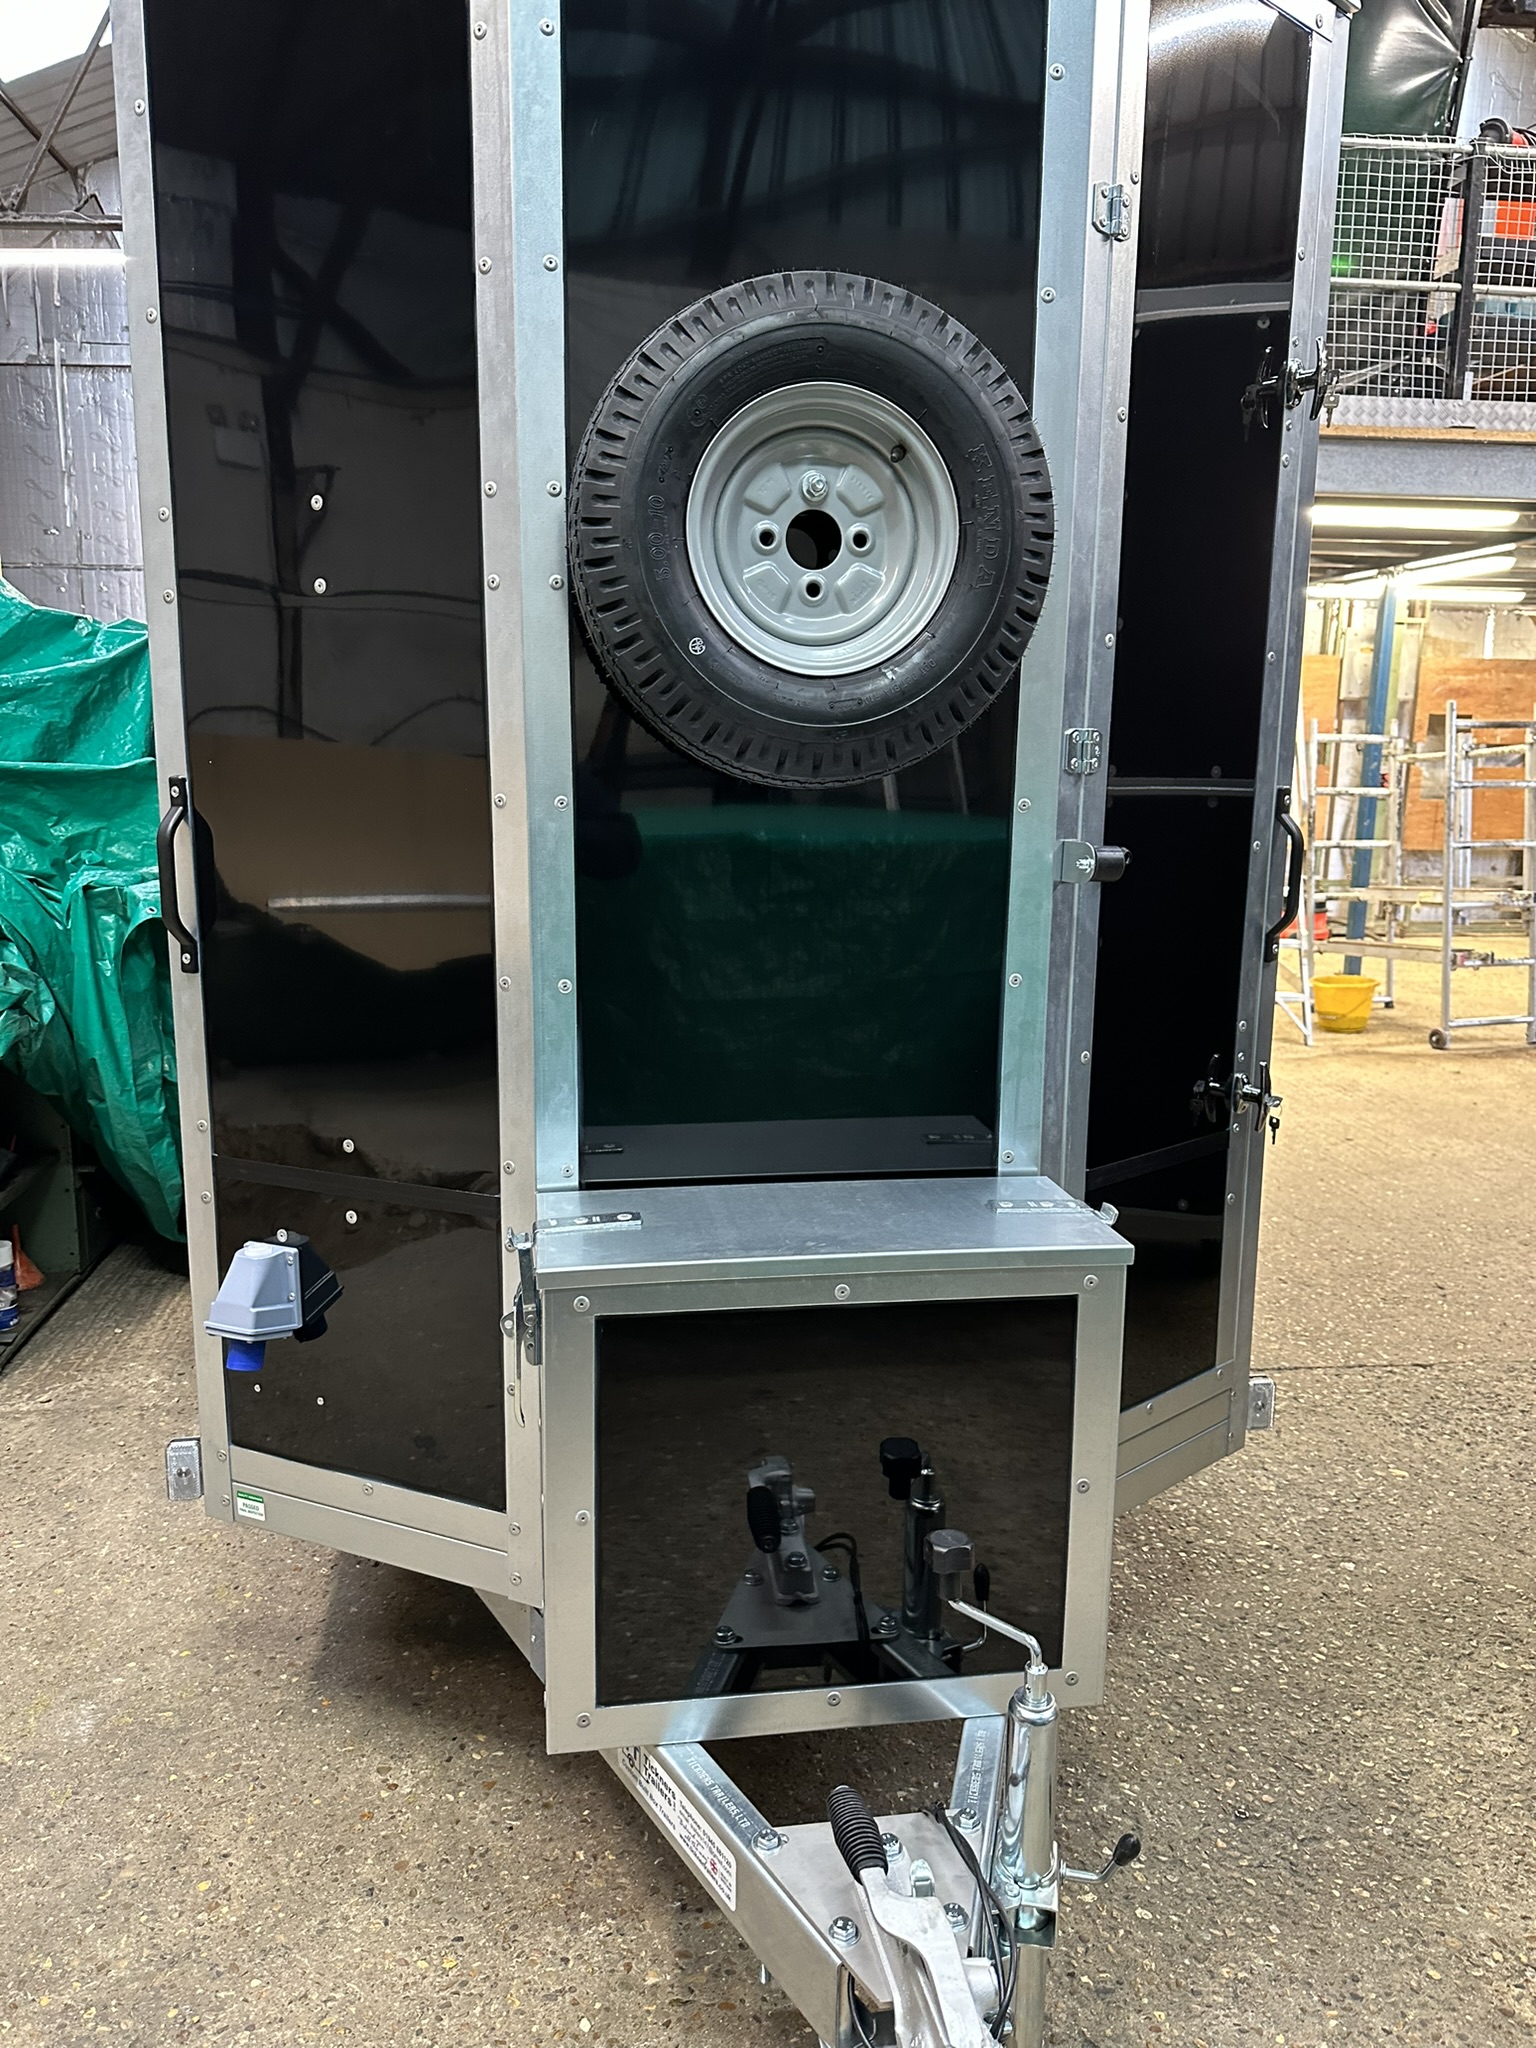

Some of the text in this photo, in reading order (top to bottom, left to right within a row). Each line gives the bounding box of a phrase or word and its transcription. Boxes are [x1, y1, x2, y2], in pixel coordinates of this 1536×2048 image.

[965, 443, 1002, 589] KENDA
[243, 1502, 259, 1511] PASSED
[643, 1753, 677, 1800] Tickners
[643, 1764, 672, 1807] Trailers
